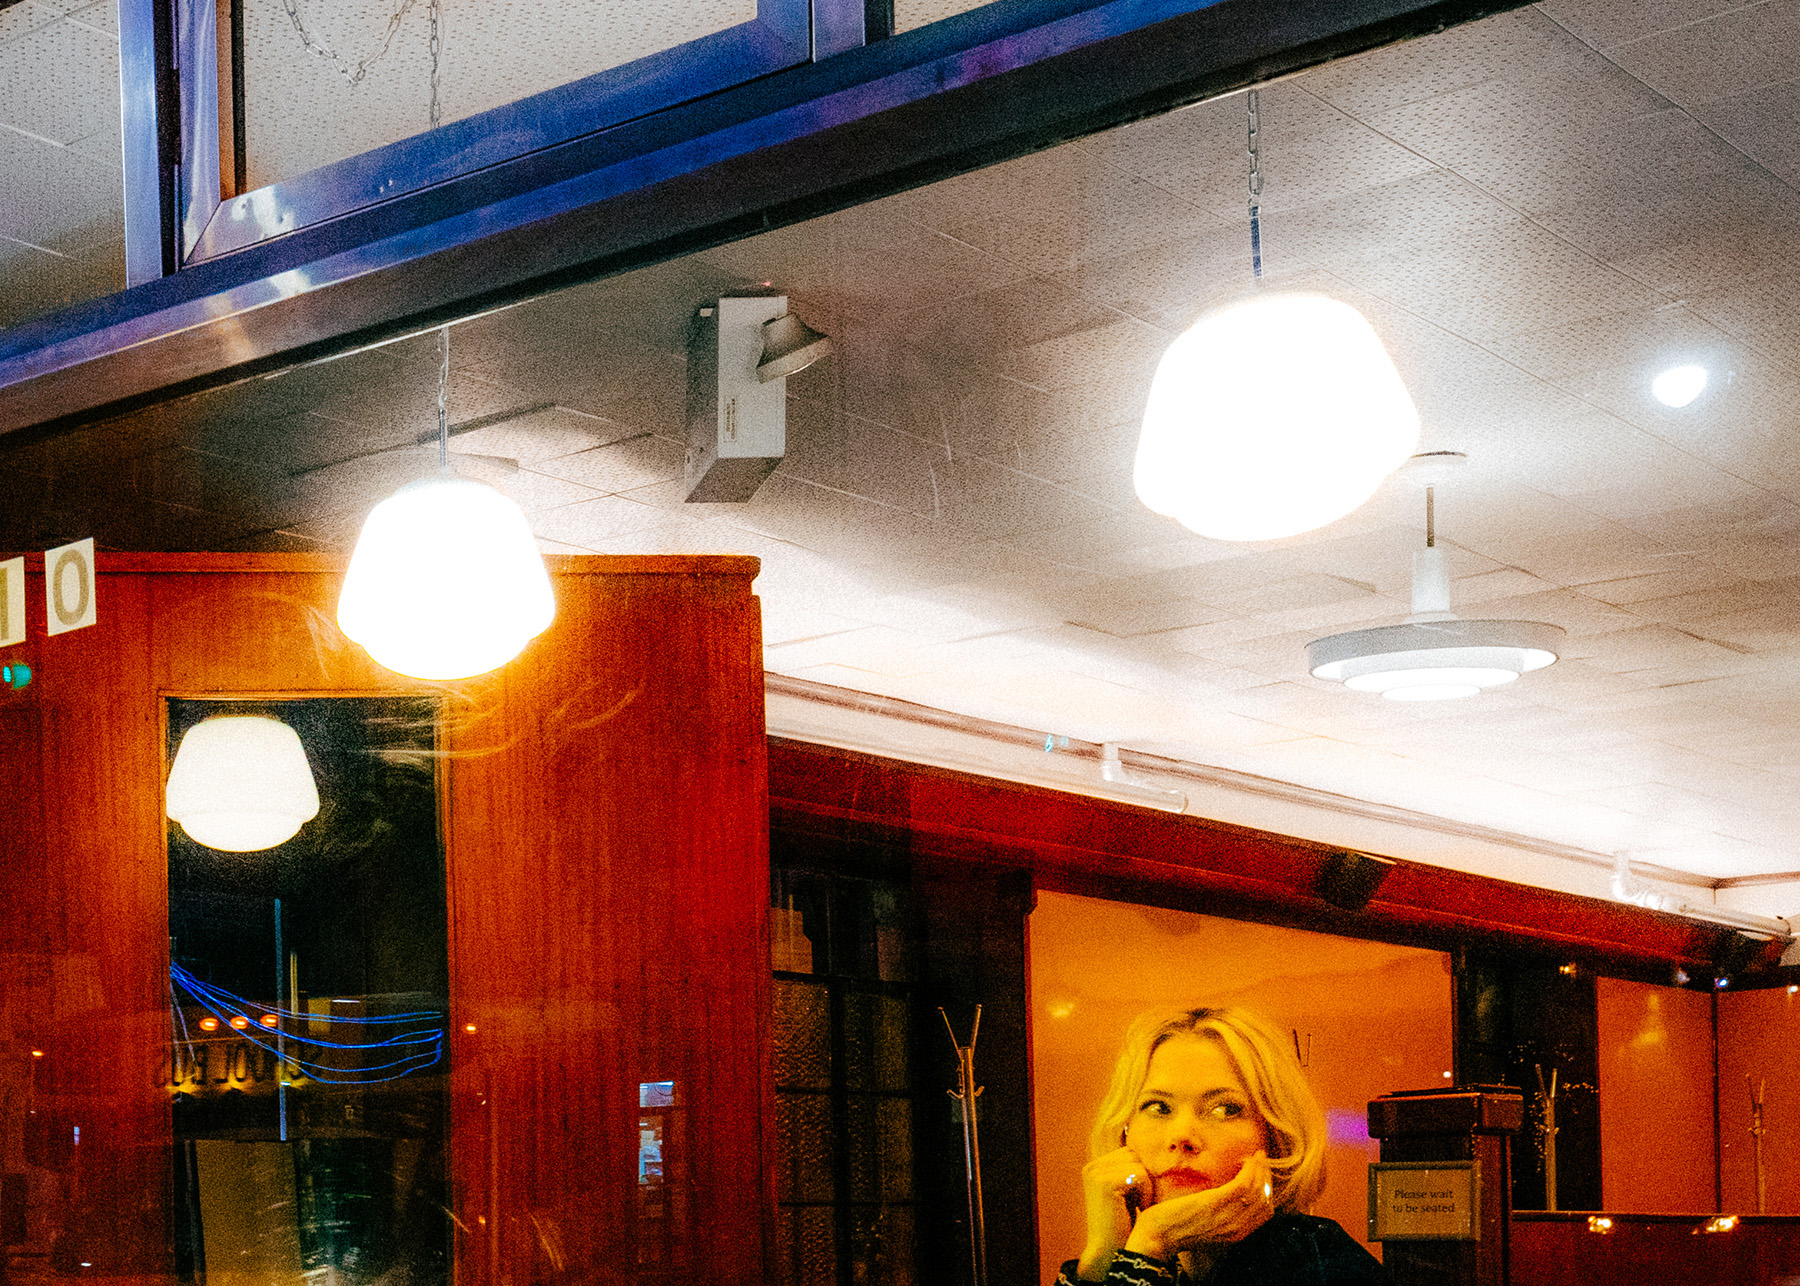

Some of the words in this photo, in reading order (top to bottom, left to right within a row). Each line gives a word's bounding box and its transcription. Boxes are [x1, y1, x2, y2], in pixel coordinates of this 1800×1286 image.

[1394, 1189, 1427, 1199] Please
[1429, 1189, 1454, 1199] wait
[1392, 1204, 1403, 1213] to
[1405, 1203, 1419, 1213] be
[1420, 1203, 1455, 1213] seated
